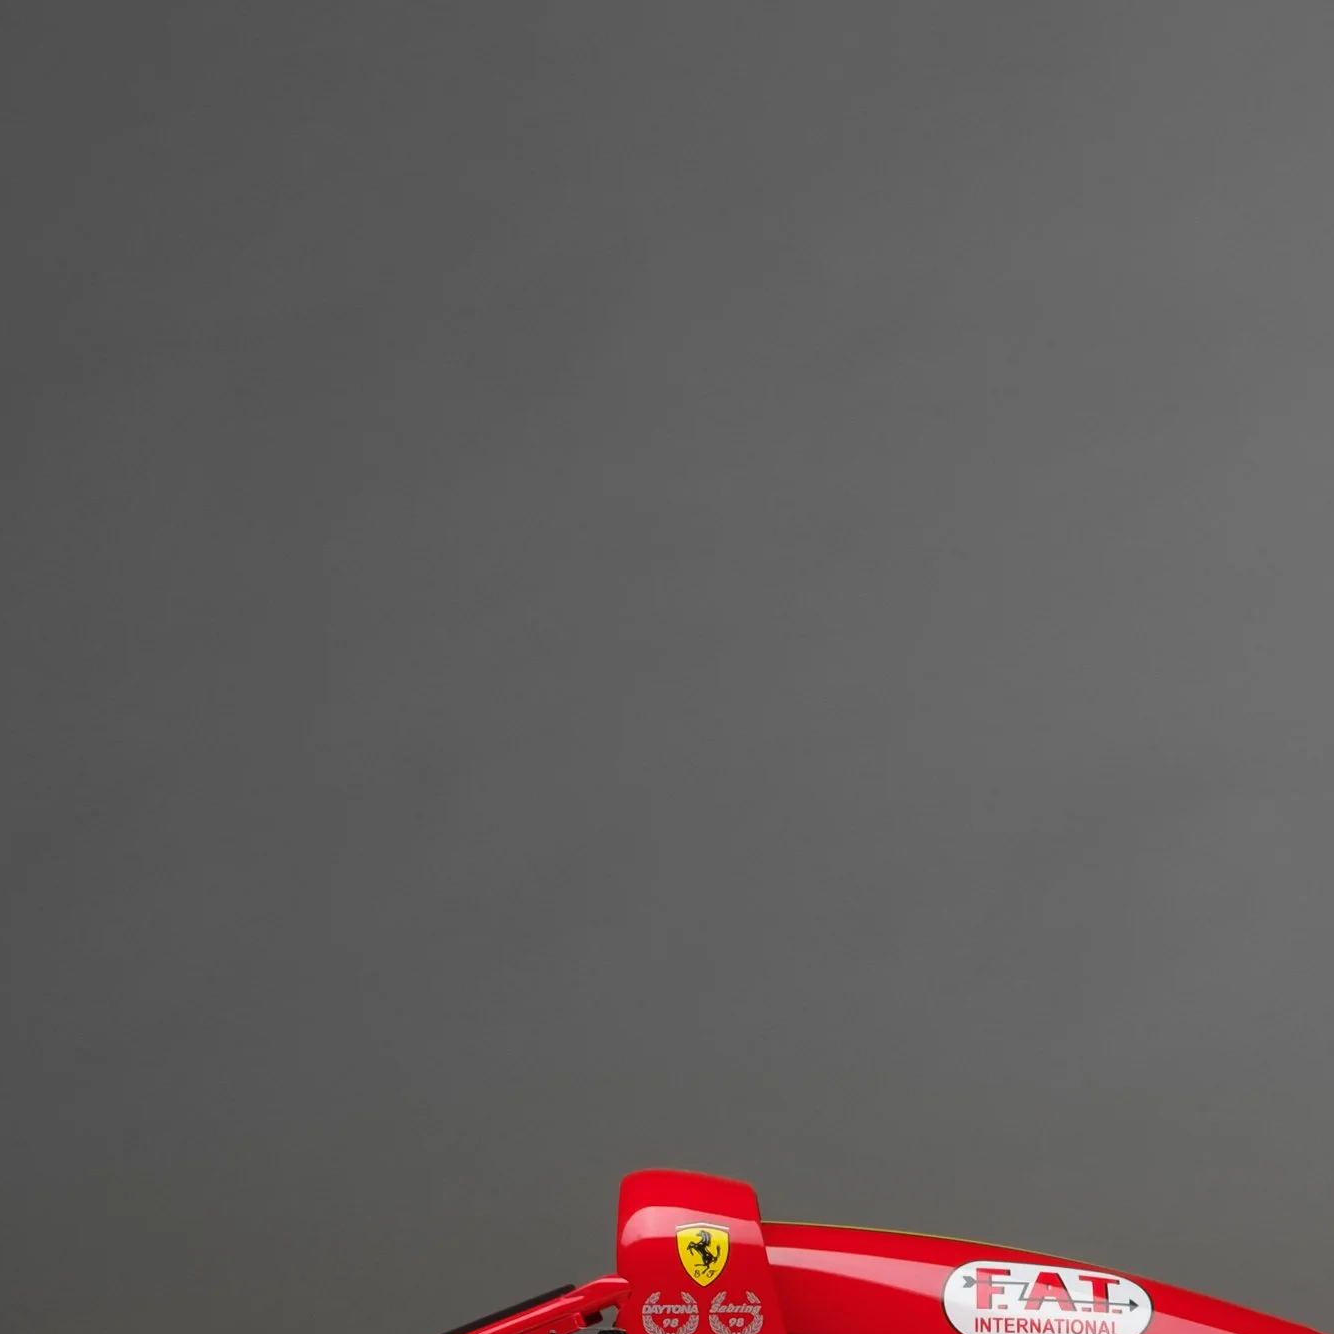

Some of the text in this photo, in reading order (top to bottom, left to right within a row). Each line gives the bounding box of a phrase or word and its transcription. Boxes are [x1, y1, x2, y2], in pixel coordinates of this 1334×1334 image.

[642, 1305, 699, 1314] DAYTONA
[709, 1303, 762, 1315] Sebring
[662, 1318, 679, 1328] 98
[728, 1318, 745, 1328] 98
